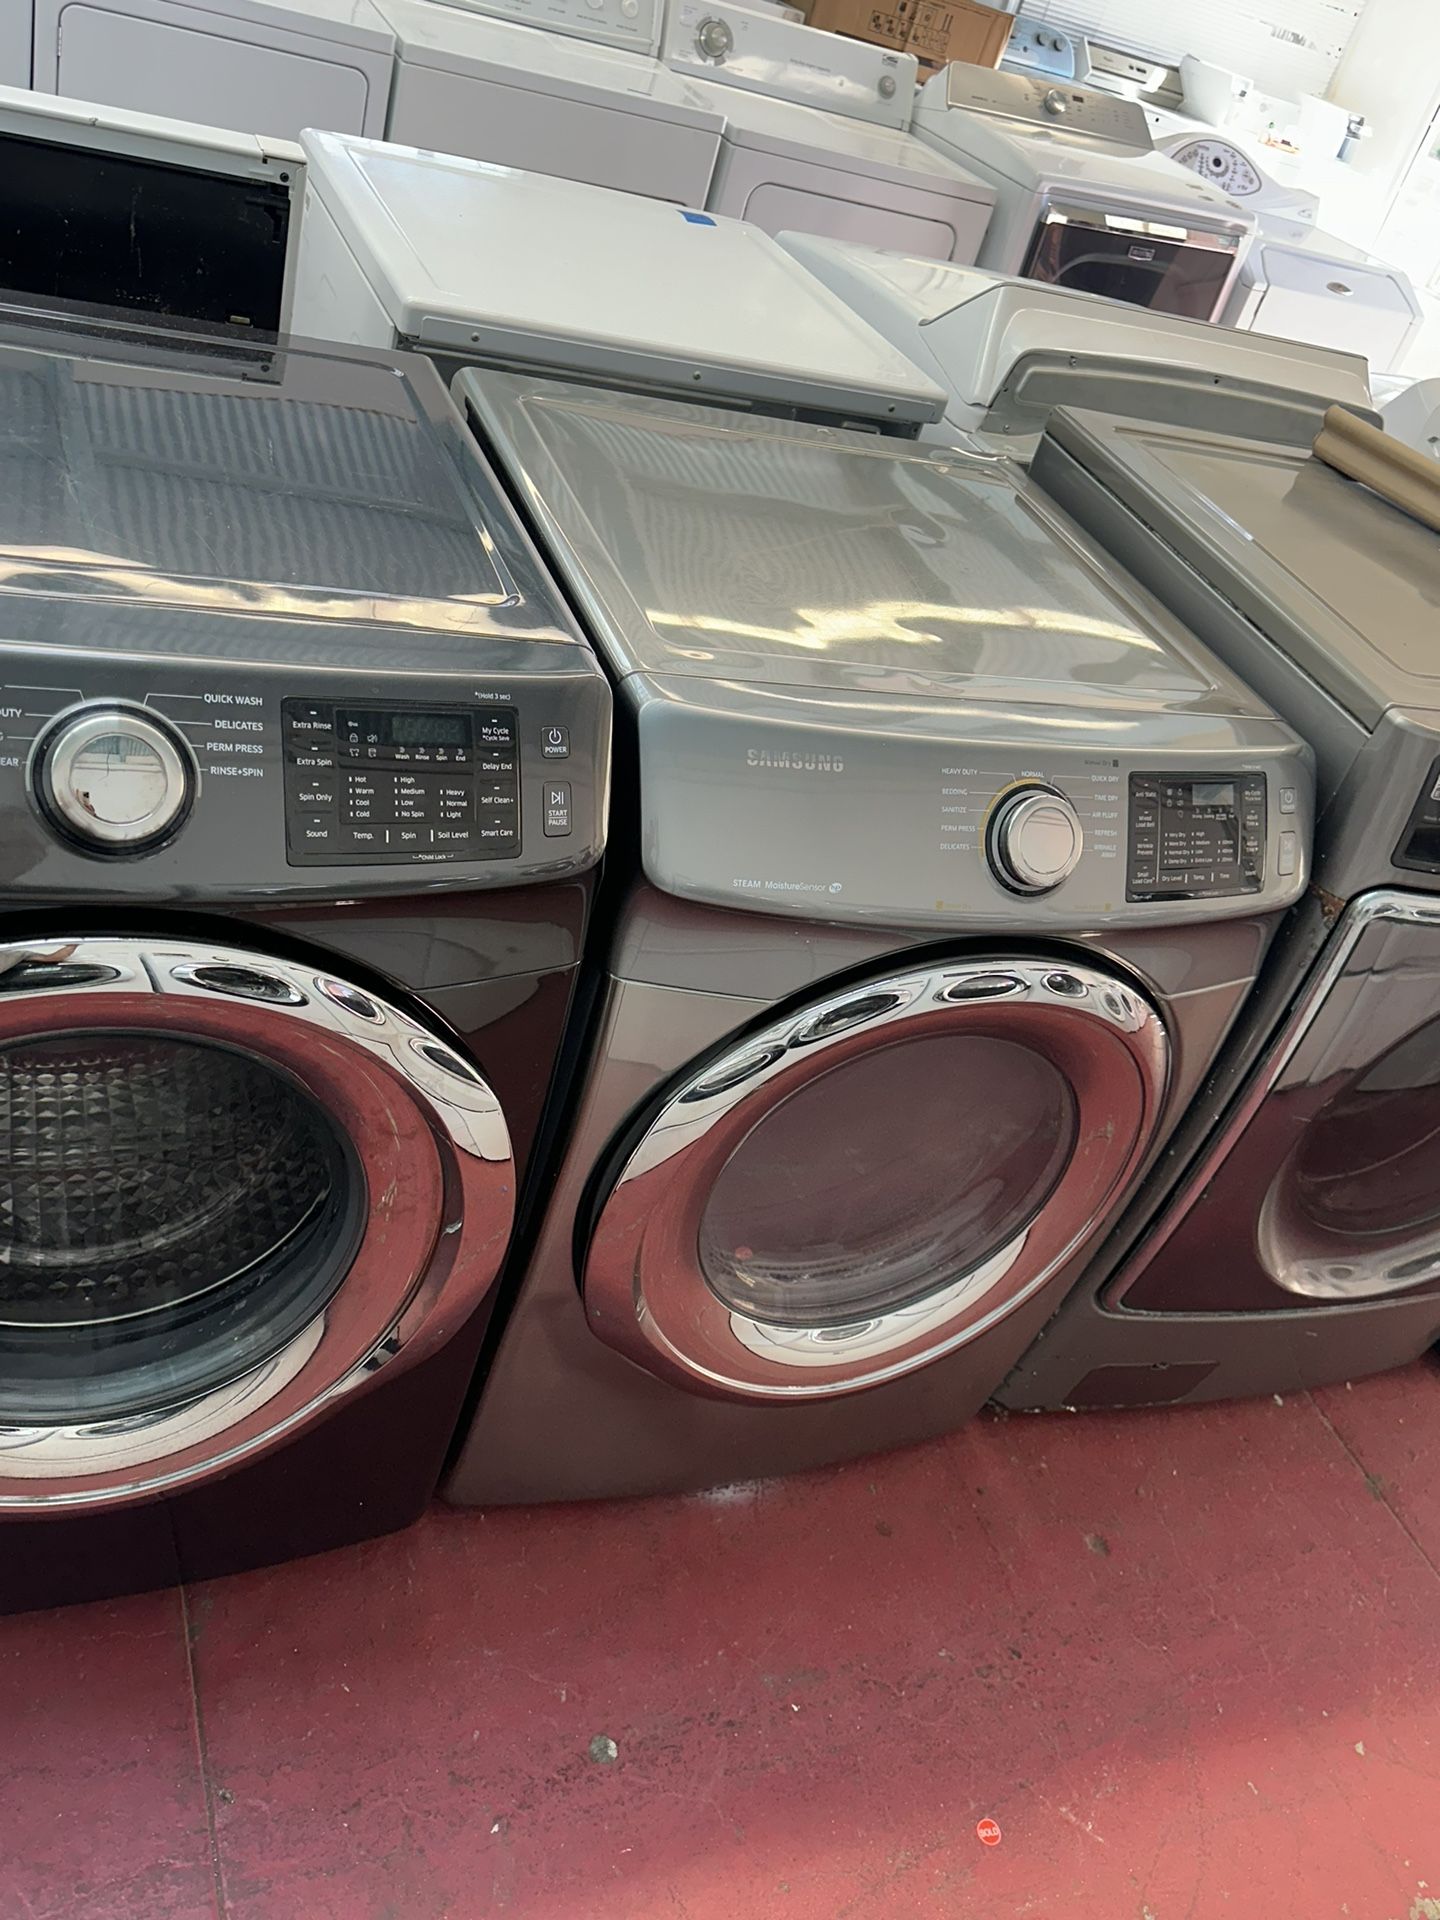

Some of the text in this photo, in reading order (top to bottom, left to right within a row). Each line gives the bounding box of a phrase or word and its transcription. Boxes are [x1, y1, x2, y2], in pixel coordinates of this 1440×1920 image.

[204, 693, 263, 706] QUICK WASH
[214, 720, 264, 731] DELICATES
[292, 721, 332, 730] Extra Rinse
[482, 727, 509, 735] My Cycle
[206, 742, 264, 754] PERM PRESS
[296, 757, 332, 767] Extra Spin
[746, 748, 844, 773] SAMSUNG
[482, 763, 500, 771] Delay
[210, 766, 264, 777] RINSE+SPIN
[962, 768, 978, 776] DUTY
[1021, 770, 1044, 778] NORMAL
[1091, 774, 1107, 782] QUICK
[446, 789, 465, 797] Heavy
[942, 788, 968, 796] BEDDING
[299, 793, 332, 802] Spin Only
[481, 796, 493, 804] Self
[446, 811, 462, 819] Light
[548, 809, 567, 817] START
[548, 818, 567, 826] PAUSE
[481, 829, 499, 837] Smart
[958, 825, 976, 833] PRESS
[306, 829, 328, 838] Sound
[401, 832, 417, 840] Spin
[438, 831, 469, 839] Soil Level
[940, 843, 970, 851] DELICATES
[732, 878, 761, 889] STEAM
